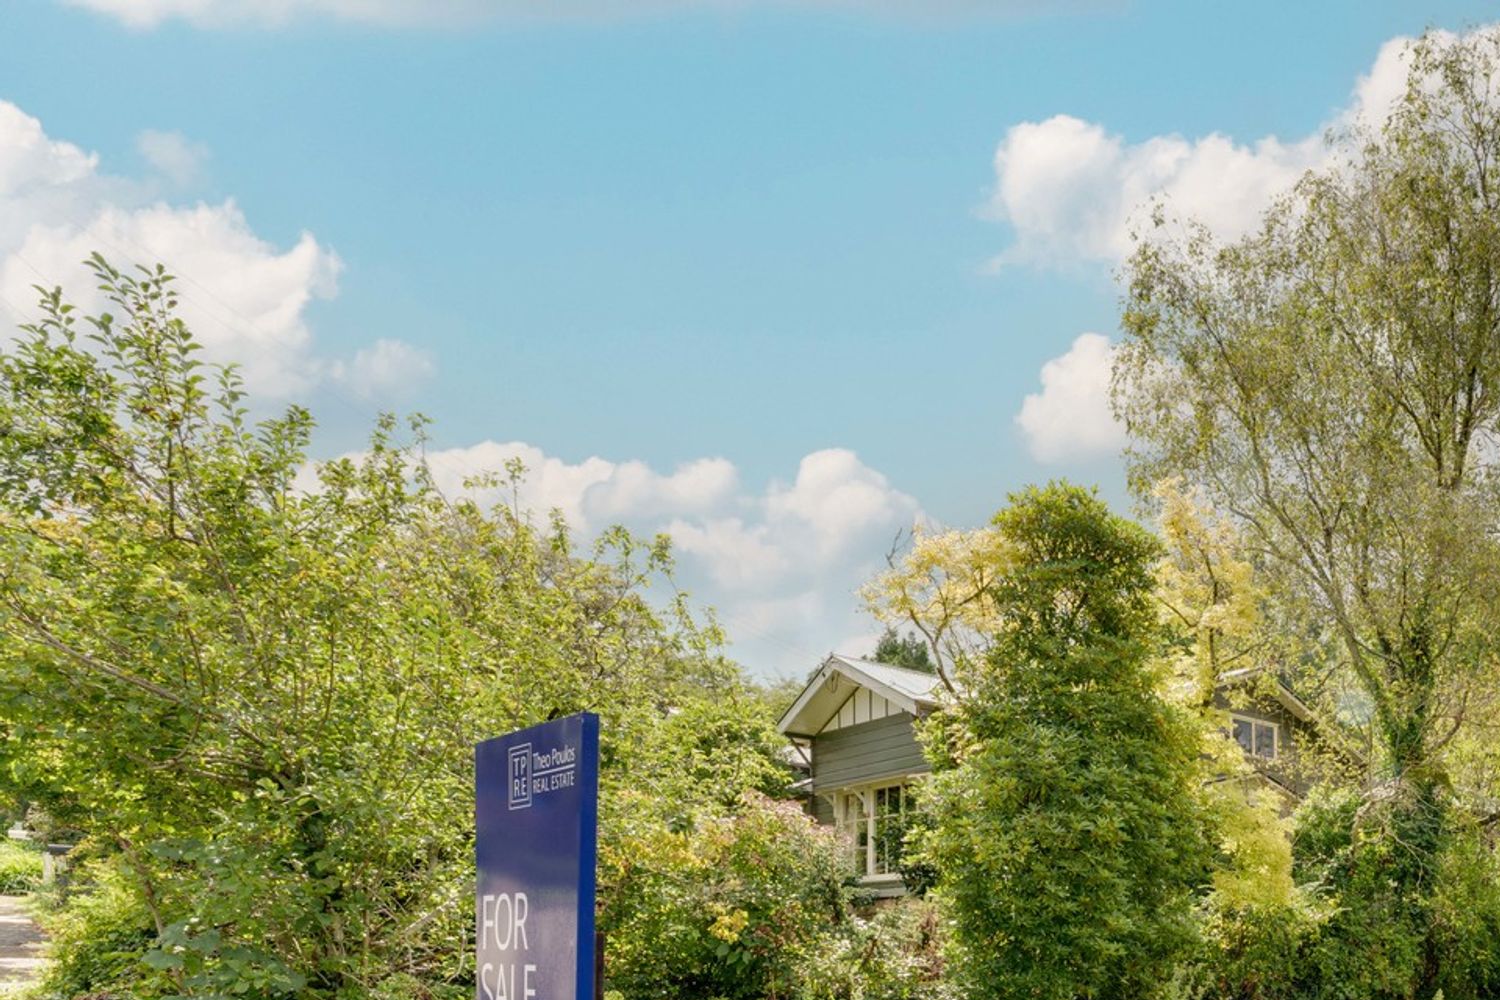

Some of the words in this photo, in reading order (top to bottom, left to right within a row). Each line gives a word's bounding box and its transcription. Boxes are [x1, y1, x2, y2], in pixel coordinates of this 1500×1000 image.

[532, 752, 551, 770] Theo
[551, 744, 576, 766] Poulos
[532, 776, 550, 794] REAL
[550, 770, 575, 791] ESTATE
[482, 892, 529, 950] FOR
